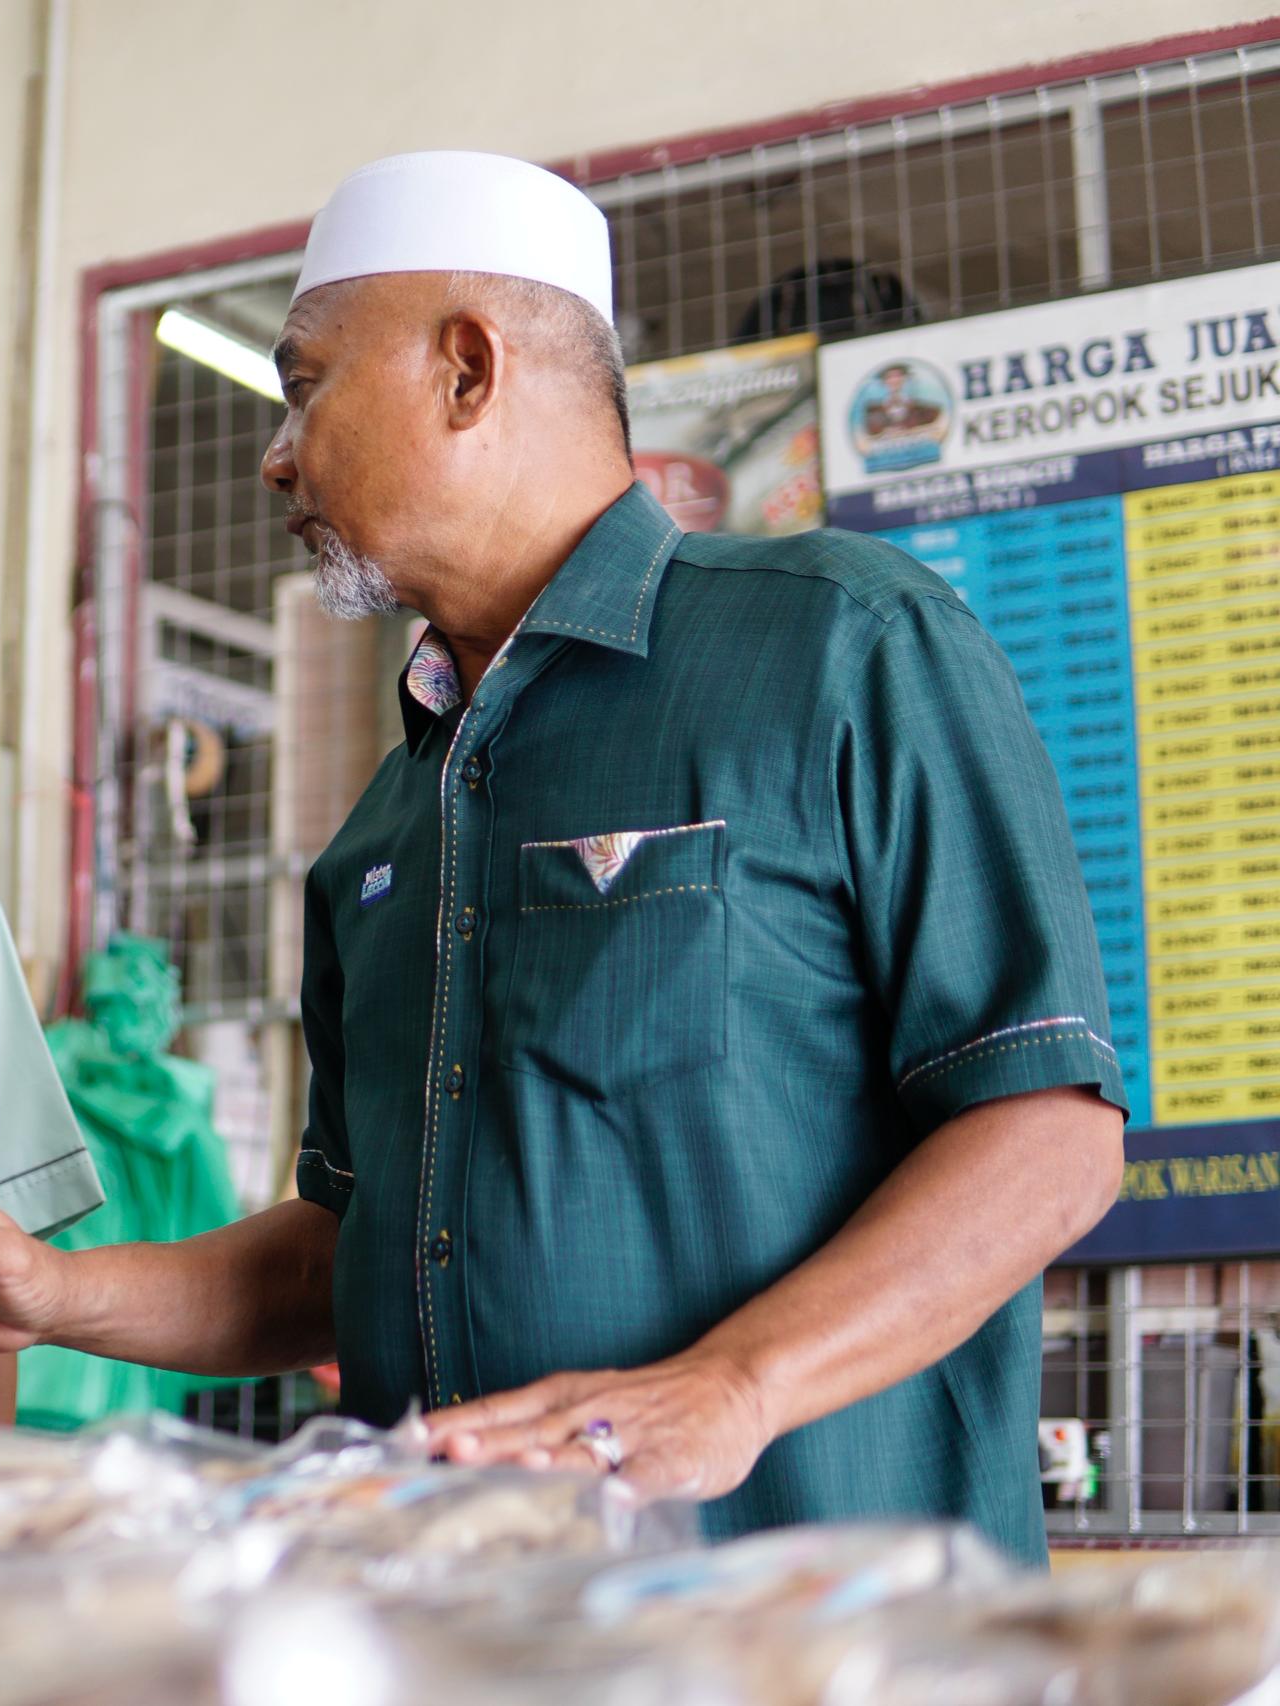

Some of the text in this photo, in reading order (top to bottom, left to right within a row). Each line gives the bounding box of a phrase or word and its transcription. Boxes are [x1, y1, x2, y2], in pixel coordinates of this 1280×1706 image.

[960, 308, 1280, 401] HARGA JUA
[962, 357, 1280, 447] KEROPOK SEJUK
[1169, 1151, 1280, 1197] WARISAN
